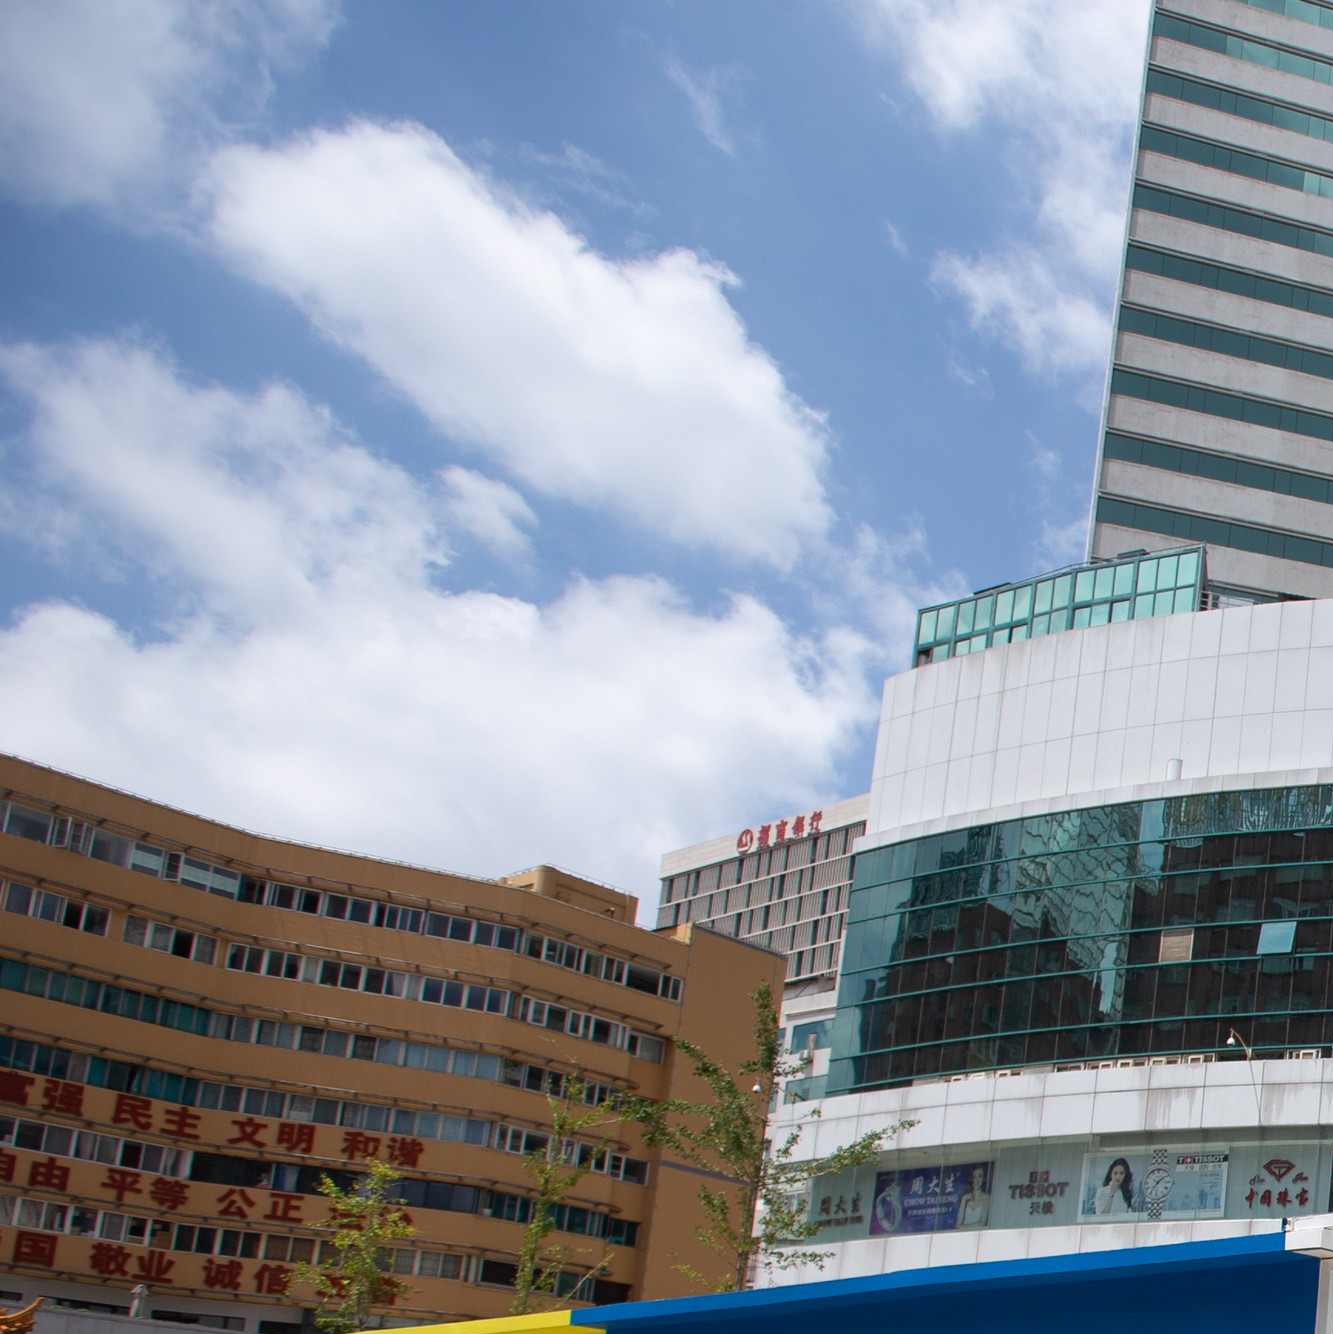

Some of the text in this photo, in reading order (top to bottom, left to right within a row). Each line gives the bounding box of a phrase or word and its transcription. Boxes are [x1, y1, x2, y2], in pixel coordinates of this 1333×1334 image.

[112, 1093, 201, 1140] 民主
[227, 1117, 315, 1154] 文明
[341, 1131, 424, 1168] 和谐
[101, 1168, 190, 1210] 平等
[216, 1187, 304, 1223] 公正
[910, 1174, 956, 1195] 周大生
[1008, 1182, 1069, 1200] TISSOT
[89, 1242, 175, 1284] 敬业
[202, 1258, 295, 1295] 诚信
